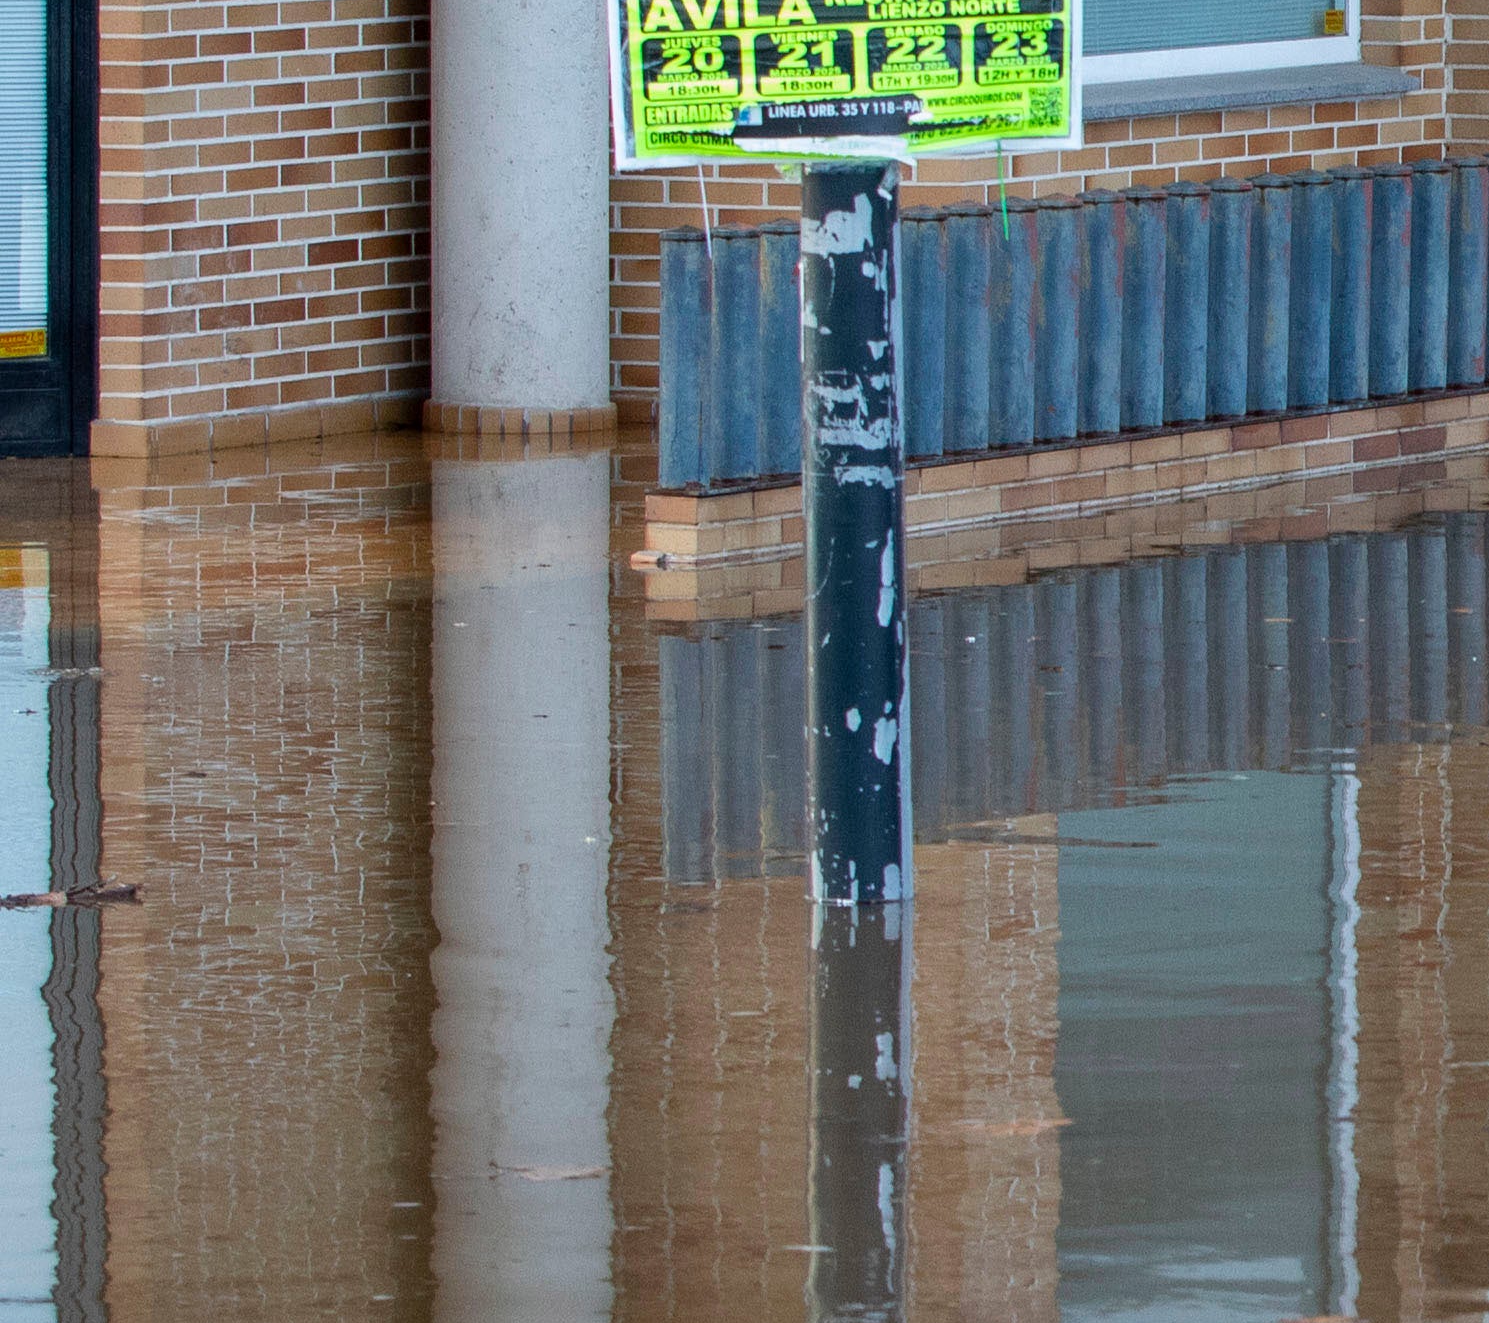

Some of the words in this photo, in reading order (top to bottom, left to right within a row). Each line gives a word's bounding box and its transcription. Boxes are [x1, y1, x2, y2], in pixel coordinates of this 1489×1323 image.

[868, 1, 945, 20] LIENZO
[986, 20, 1053, 34] DOMINGO
[661, 36, 722, 50] JUEVES
[770, 30, 838, 44] VIERNES
[886, 37, 947, 63] 22
[991, 32, 1048, 58] 23
[661, 47, 724, 74] 20
[777, 41, 834, 68] 21
[770, 68, 812, 77] MARZO
[882, 62, 922, 72] MARZO
[983, 70, 1010, 81] 12H
[1015, 70, 1023, 79] Y
[1030, 67, 1057, 78] 18H
[657, 72, 699, 82] MARZO
[878, 76, 902, 87] 17H
[906, 75, 912, 85] Y
[918, 74, 955, 85] 19:30H
[668, 84, 720, 96] 18:30H
[781, 81, 833, 92] 18:30H
[645, 104, 734, 125] ENTRADAS
[768, 105, 806, 119] LINEA
[808, 103, 839, 117] URB.
[841, 103, 858, 116] 35
[860, 102, 871, 115] Y
[650, 131, 687, 145] CIRCO
